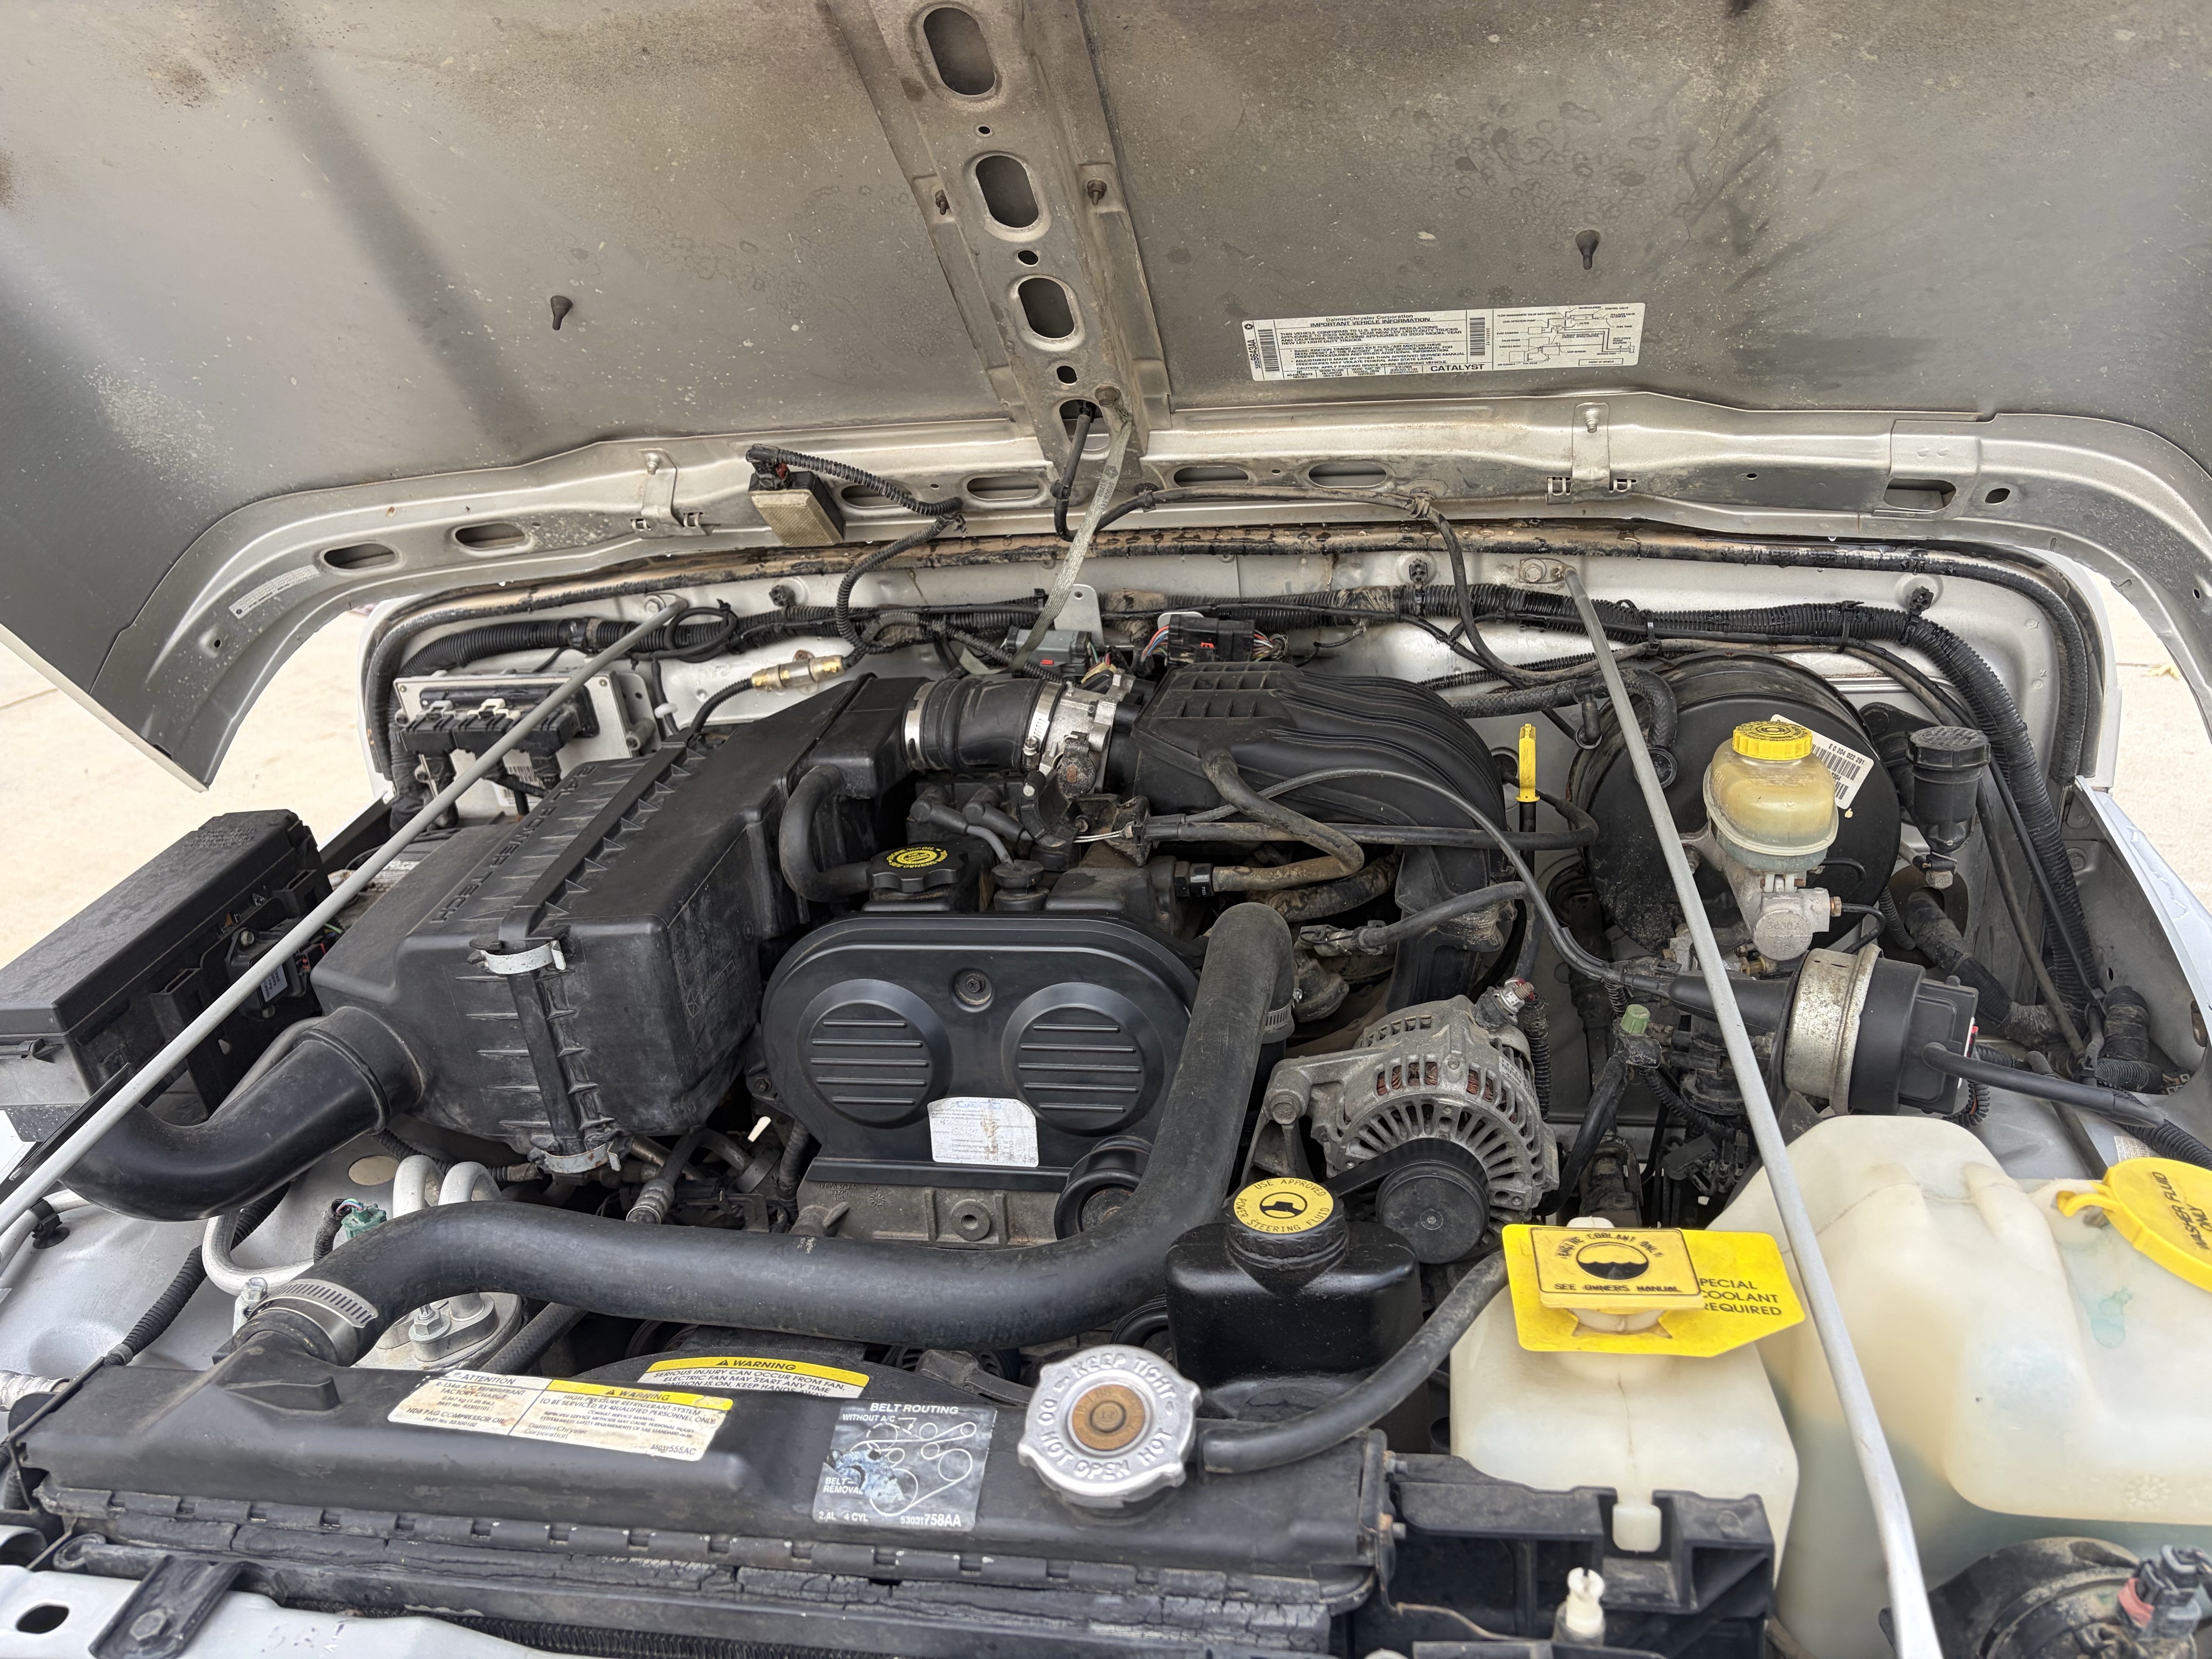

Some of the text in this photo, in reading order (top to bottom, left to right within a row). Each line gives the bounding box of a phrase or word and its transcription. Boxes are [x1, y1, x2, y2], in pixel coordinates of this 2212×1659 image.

[1837, 748, 1846, 756] 204
[1846, 752, 1856, 761] 022
[1855, 757, 1865, 765] 291
[490, 806, 556, 868] POWER
[430, 871, 493, 923] TECH
[1253, 1179, 1326, 1196] USE APPROVED
[1236, 1198, 1329, 1232] POWER STEERING FLUID
[2152, 1171, 2210, 1250] WASHER FLUID
[2187, 1204, 2212, 1232] ONLY
[1557, 1232, 1664, 1259] ENGINE COOLANT ONLY
[1699, 1278, 1758, 1290] PECIAL
[733, 1360, 797, 1370] WARNING
[462, 1374, 516, 1384] ATTENTION
[654, 1370, 691, 1378] SERIOUS
[754, 1371, 791, 1380] OCCUR
[792, 1376, 822, 1384] FROM
[823, 1381, 845, 1391] FAN,
[1071, 1353, 1176, 1398] KEEP TIGHT
[477, 1386, 525, 1395] REFRIGERANT
[808, 1384, 831, 1393] TIME
[620, 1391, 670, 1400] WARNING
[563, 1395, 701, 1415] HIGH-PRESSURE REFRIGERANT SYSTEM
[870, 1403, 958, 1414] BELT ROUTING
[442, 1412, 491, 1422] COMPRESSOR
[649, 1410, 692, 1421] PERSONNEL
[524, 1428, 568, 1439] Corporation
[529, 1423, 588, 1434] DaimlerChrysler
[1075, 1460, 1130, 1480] OPEN
[1138, 1427, 1172, 1467] HOT
[823, 1485, 864, 1495] REMOVAL
[852, 1513, 869, 1522] CYL
